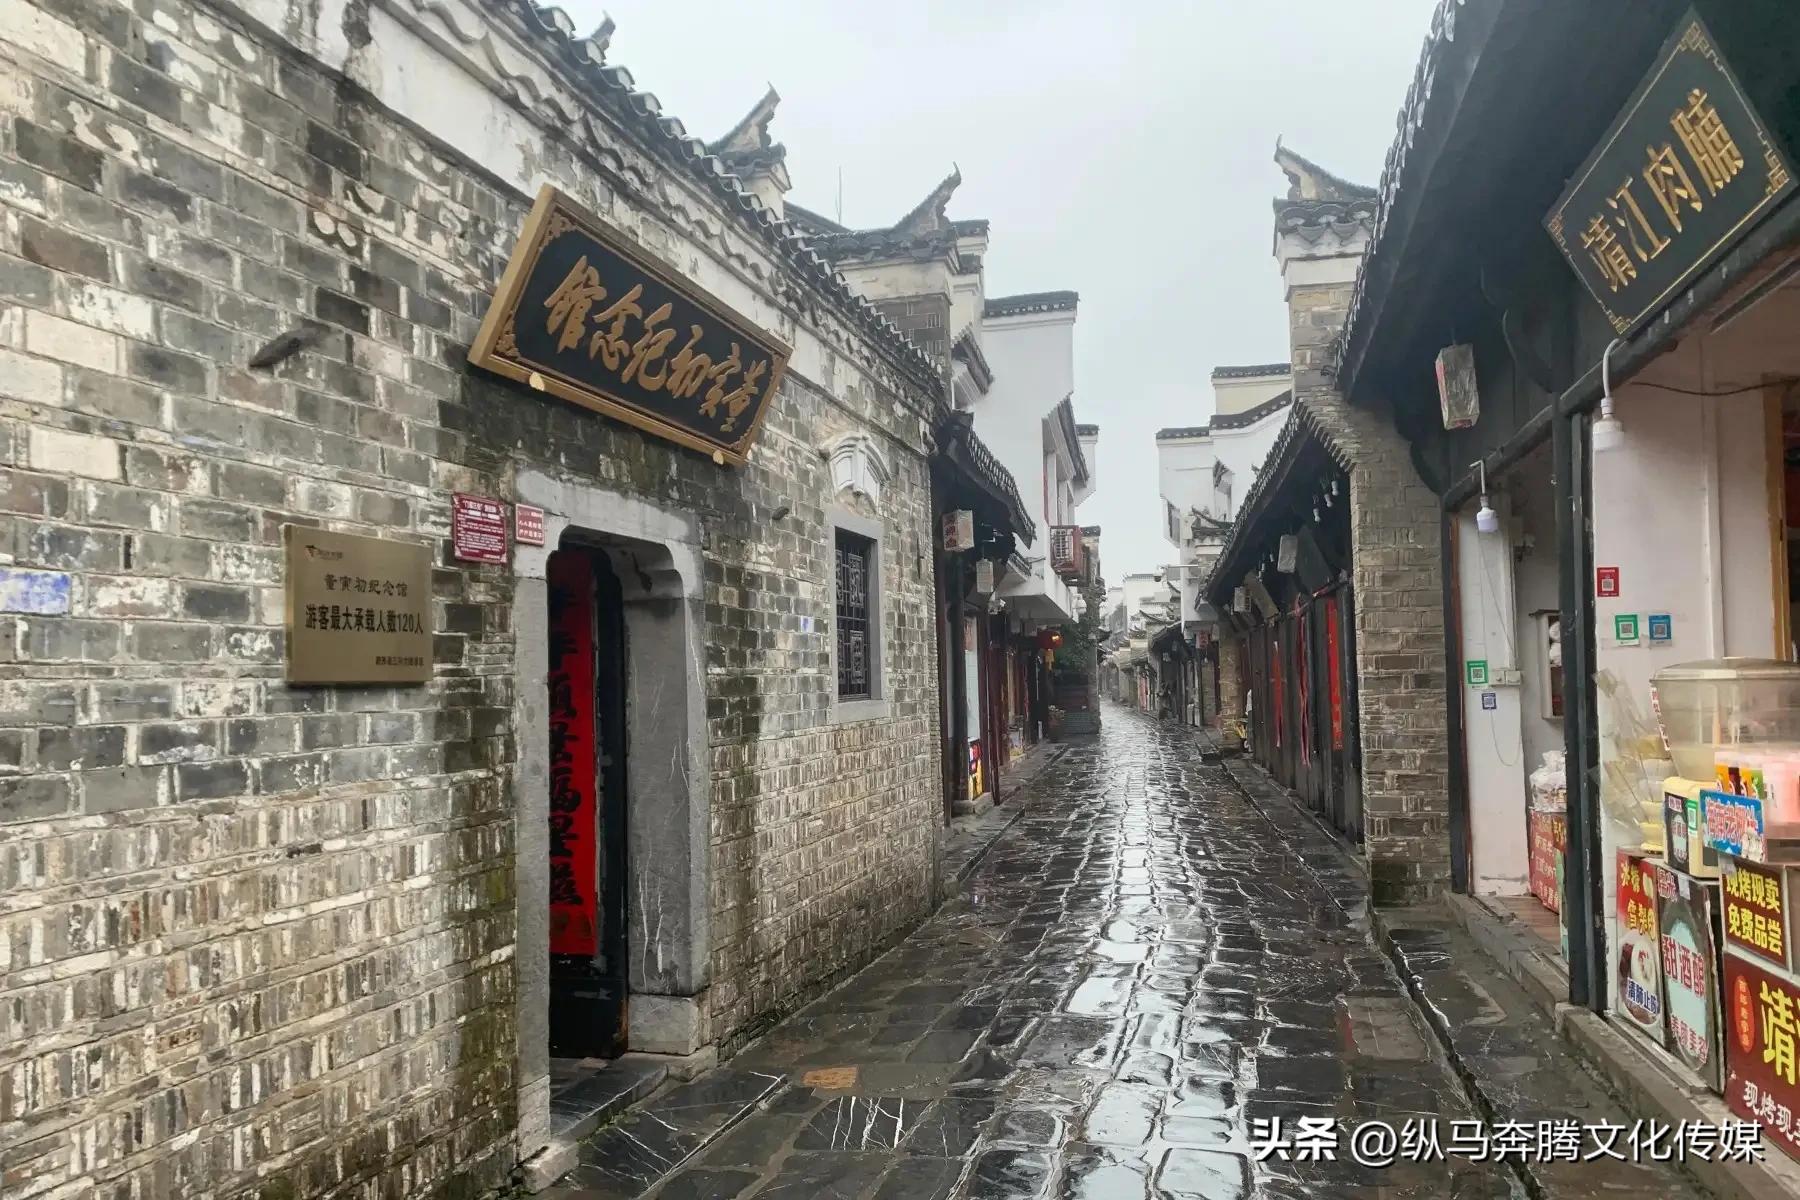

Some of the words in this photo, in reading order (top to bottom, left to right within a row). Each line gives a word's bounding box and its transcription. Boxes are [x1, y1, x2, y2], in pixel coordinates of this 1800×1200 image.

[1579, 87, 1744, 293] 靖江肉脯
[324, 573, 409, 598] 董寅初纪念馆
[305, 603, 425, 635] 游客最大承载人数120人
[1620, 859, 1641, 894] 冰糖
[1726, 866, 1781, 914] 现烤现卖
[1727, 902, 1783, 956] 免费品尝
[1759, 979, 1800, 1088] 靖
